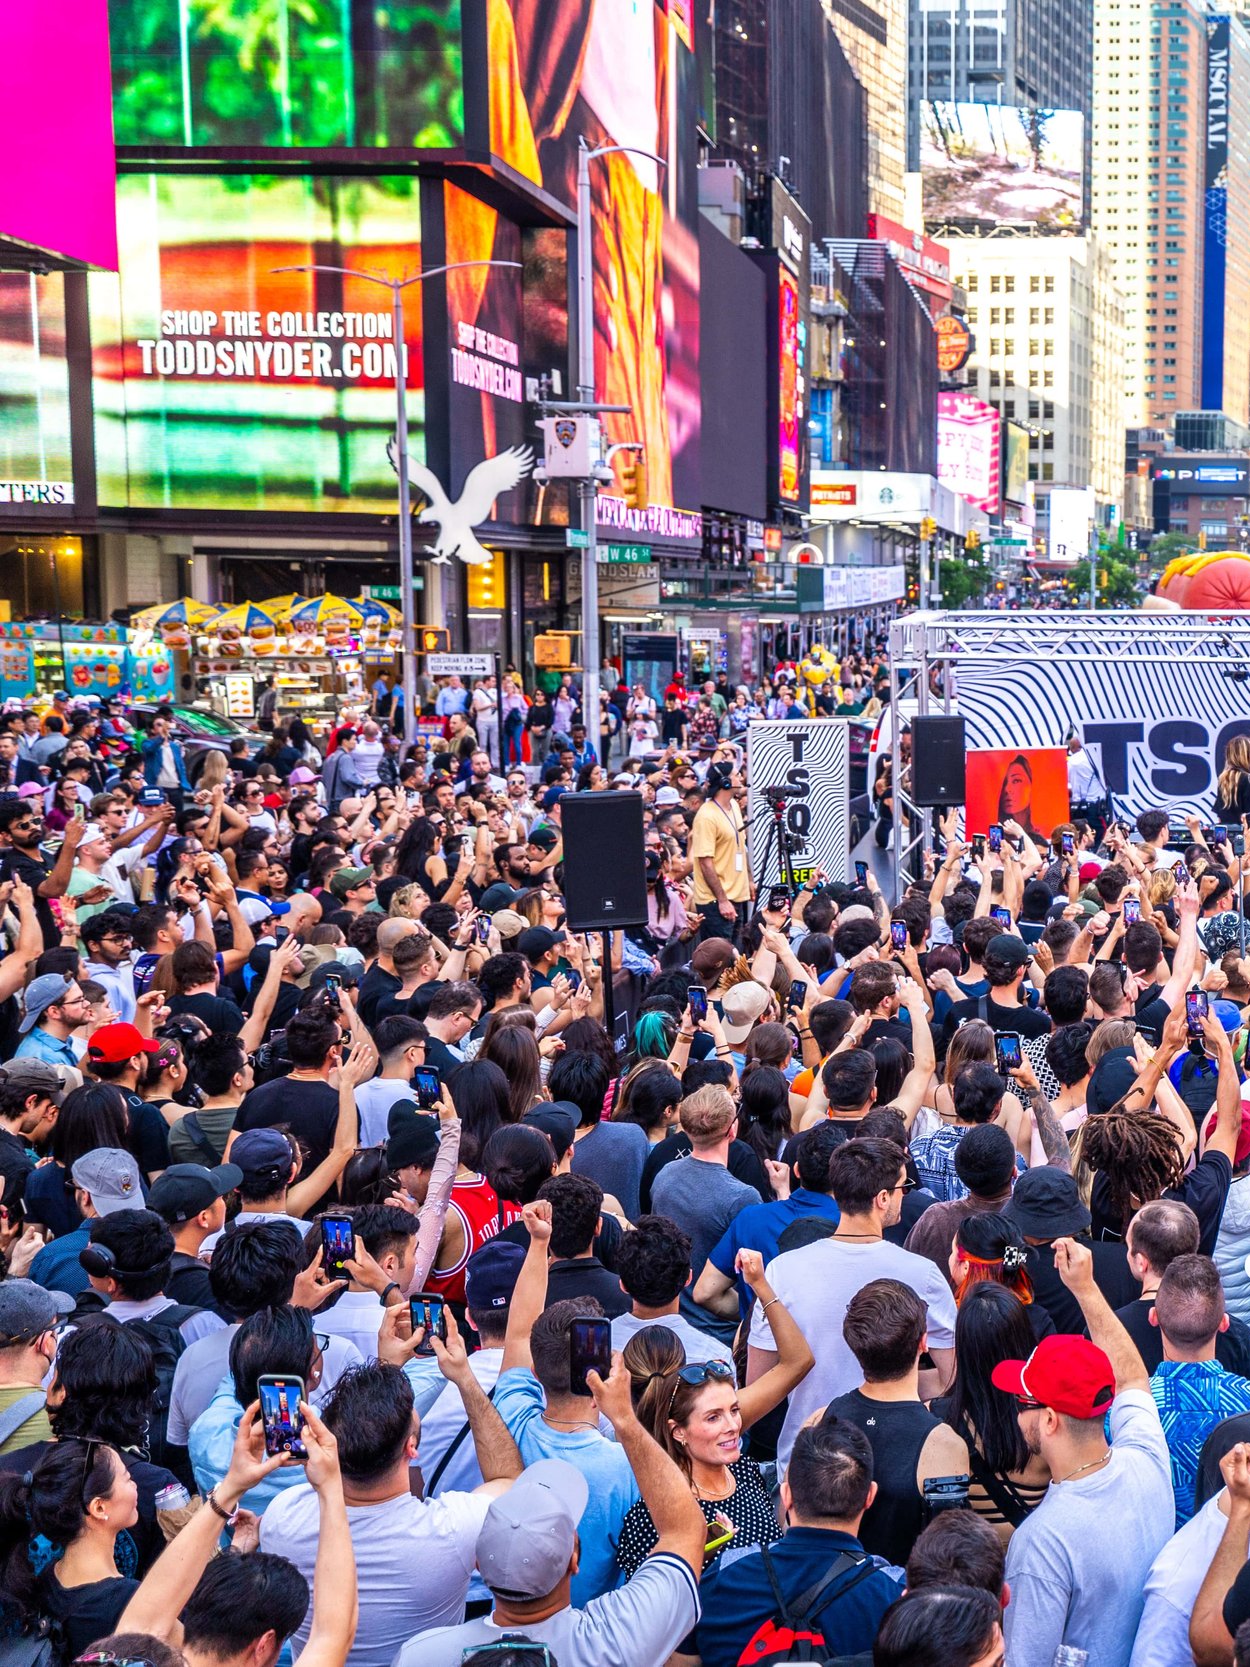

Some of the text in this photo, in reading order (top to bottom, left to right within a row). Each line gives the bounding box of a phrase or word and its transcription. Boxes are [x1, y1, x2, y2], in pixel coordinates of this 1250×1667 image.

[161, 310, 392, 338] SHOP THE COLLECTION
[137, 339, 408, 378] TODDSNYDER.COM
[610, 549, 619, 560] W
[625, 549, 638, 561] 46
[620, 564, 657, 578] SLAM
